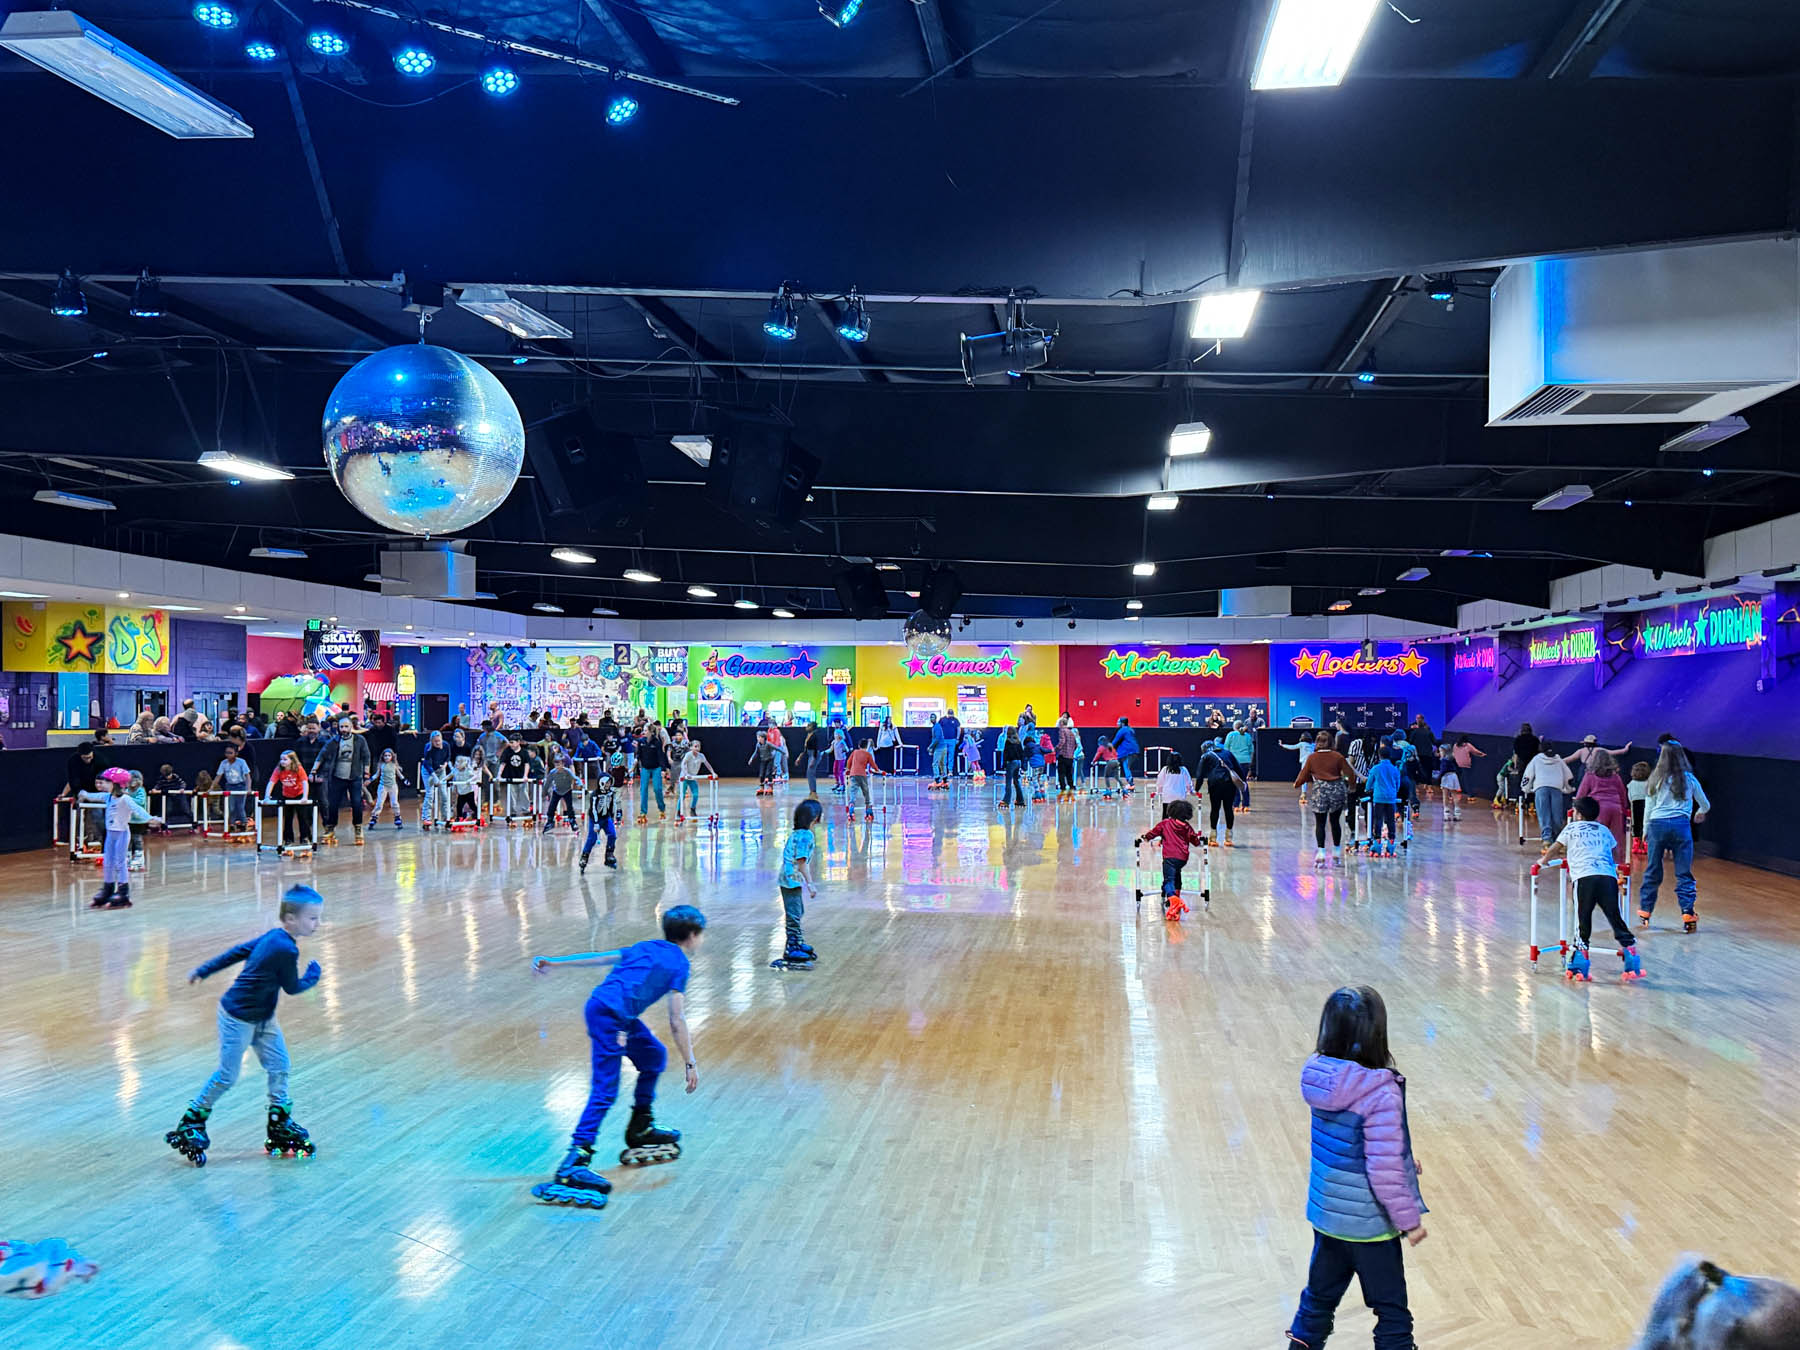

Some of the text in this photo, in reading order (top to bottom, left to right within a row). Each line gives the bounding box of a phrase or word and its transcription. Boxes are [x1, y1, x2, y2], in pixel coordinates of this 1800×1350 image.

[1654, 605, 1762, 650] Wheels DURHAM
[109, 614, 163, 668] DJ
[322, 633, 362, 644] SKATE
[1536, 631, 1596, 661] Wheels DURHA
[319, 644, 365, 655] RENTAL
[617, 645, 628, 663] 2
[657, 648, 679, 658] BUY
[1364, 642, 1375, 661] 1
[655, 662, 683, 673] HERE
[725, 654, 793, 678] Games
[928, 654, 995, 677] Games
[1123, 653, 1202, 678] Lockers
